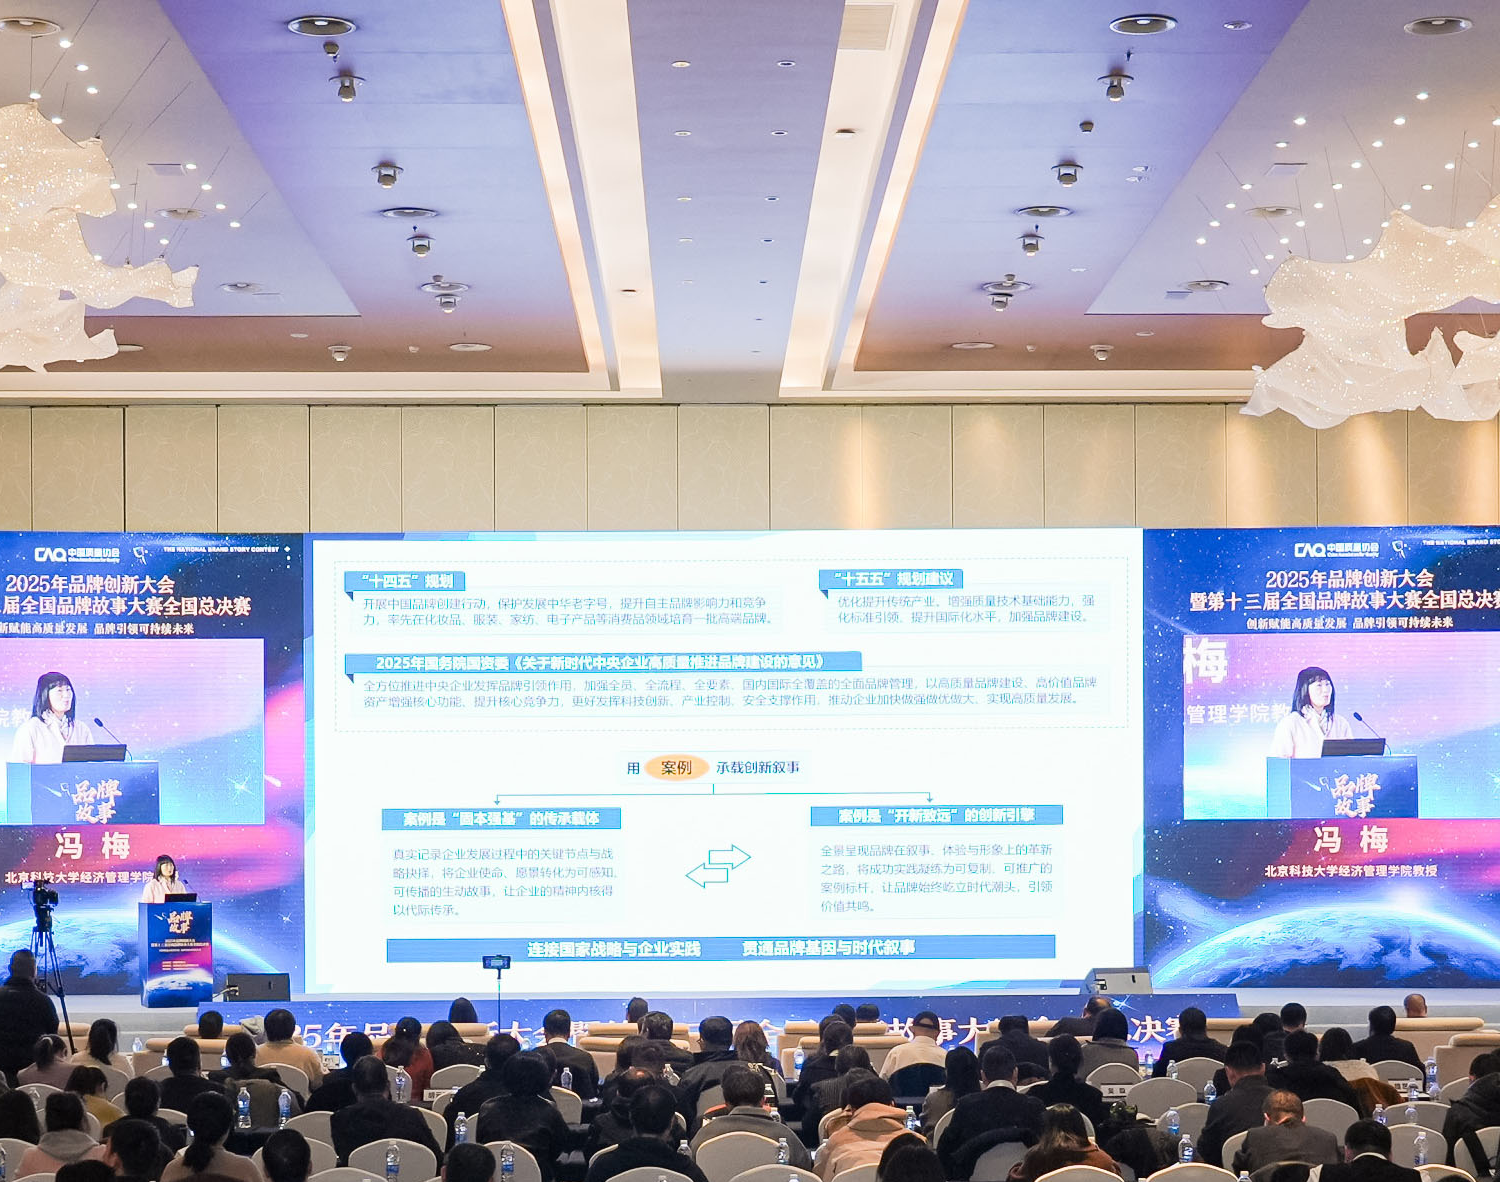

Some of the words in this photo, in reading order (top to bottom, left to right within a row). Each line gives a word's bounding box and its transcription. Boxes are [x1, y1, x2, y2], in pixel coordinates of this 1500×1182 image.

[5, 574, 176, 595] 2025年品牌创新大会
[1265, 569, 1435, 589] 2025年品牌创新大会
[93, 621, 195, 635] 品牌引领可持续未来
[1246, 616, 1348, 631] 创新赋能高质量发展
[1352, 616, 1455, 630] 品牌引领可持续未来
[1183, 638, 1228, 686] 梅
[627, 761, 640, 775] 用
[661, 760, 693, 776] 案例
[716, 760, 800, 775] 承载创新叙事
[71, 779, 122, 807] 品牌
[1331, 773, 1381, 801] 品牌
[76, 802, 117, 824] 故事
[1334, 796, 1376, 818] 故事
[393, 848, 614, 861] 真实记录企业发展过程中的关键节点与战
[5, 871, 179, 884] 北京科技大学经济管理学院
[1264, 864, 1439, 878] 北京科技大学经济管理学院教授
[393, 904, 459, 917] 以代际传承。
[820, 900, 874, 913] 价值共鸣。
[527, 941, 702, 958] 连接国家战略与企业实践
[742, 939, 916, 956] 贯通品牌基因与时代叙事
